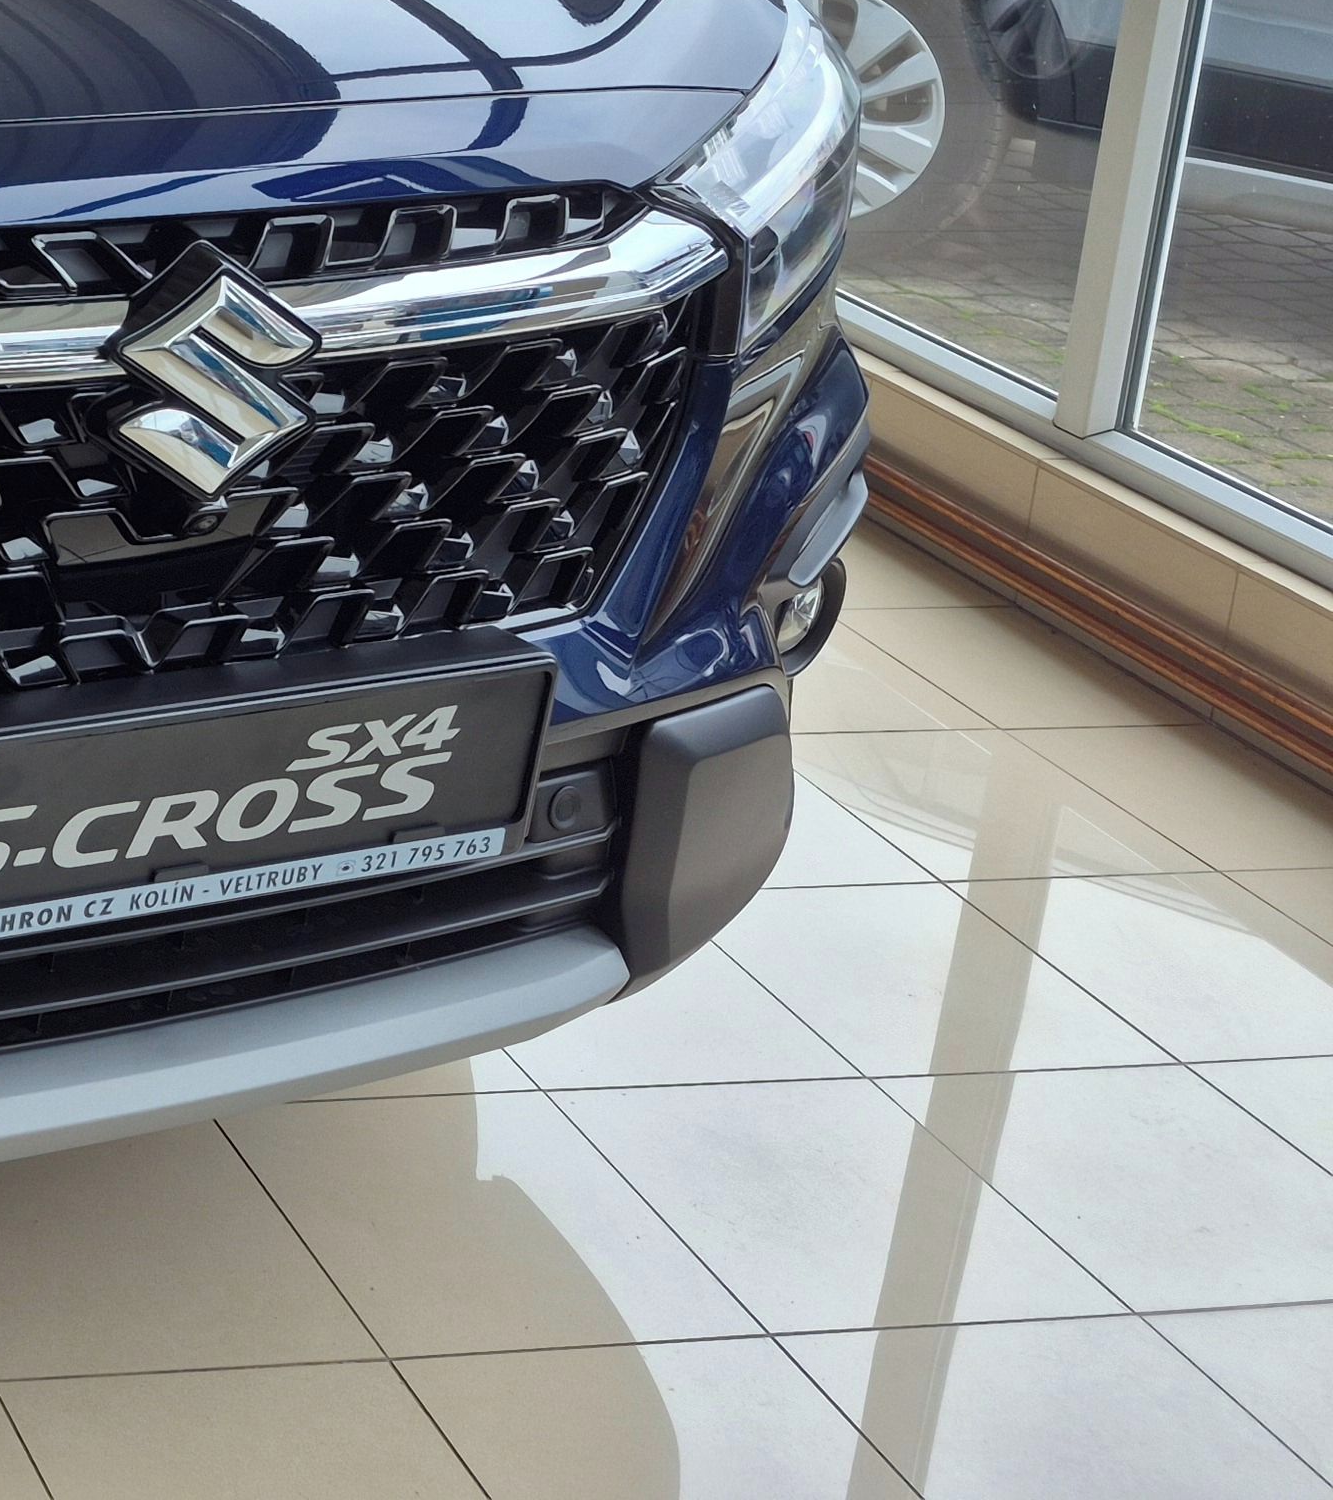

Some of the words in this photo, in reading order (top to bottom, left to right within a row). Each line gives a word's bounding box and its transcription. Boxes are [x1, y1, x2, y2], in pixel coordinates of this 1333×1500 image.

[285, 704, 461, 772] SX4
[0, 904, 73, 933] HRON
[84, 897, 116, 919] CZ
[129, 881, 195, 911] KOLÍN
[219, 862, 324, 896] VELTRUBY
[360, 851, 398, 873] 321
[407, 843, 446, 866] 795
[453, 836, 491, 857] 763
